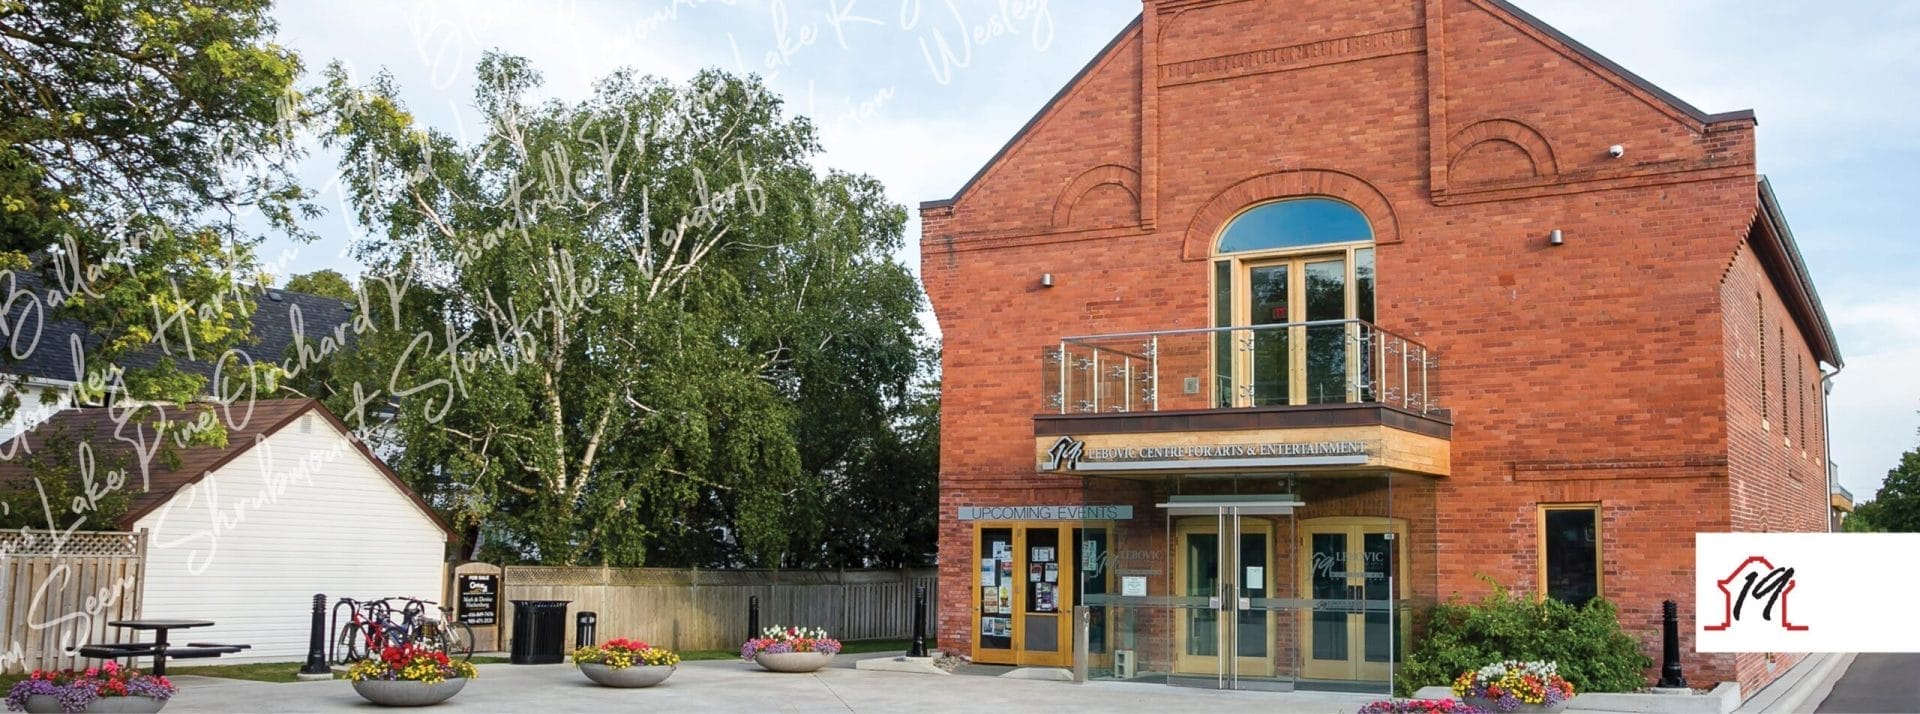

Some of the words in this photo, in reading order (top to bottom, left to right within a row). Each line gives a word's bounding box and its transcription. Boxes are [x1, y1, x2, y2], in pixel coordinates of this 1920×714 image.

[1088, 447, 1137, 459] LEBOVIC
[1139, 446, 1185, 458] CENTRE
[1188, 445, 1211, 457] FOR
[1214, 444, 1244, 457] ARTS
[1246, 444, 1257, 456] &
[1260, 441, 1367, 456] ENTERTAINMENT
[971, 506, 1051, 520] UPCOMING
[1058, 505, 1118, 519] EVENTS
[1336, 551, 1384, 562] LEVIC
